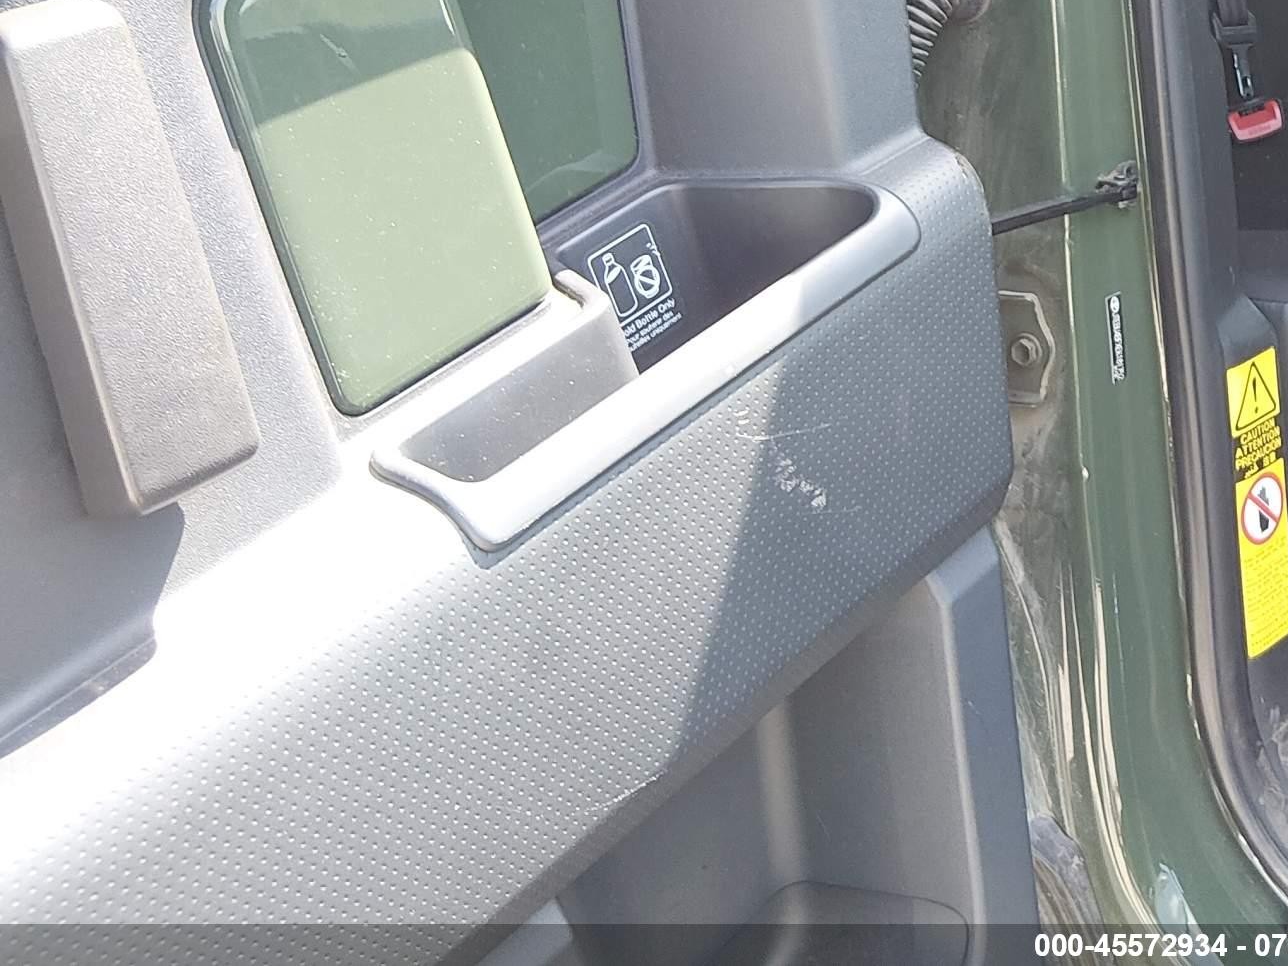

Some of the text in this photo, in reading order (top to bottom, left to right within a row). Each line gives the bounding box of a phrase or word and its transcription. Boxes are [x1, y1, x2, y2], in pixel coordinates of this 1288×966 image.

[624, 298, 675, 336] old Bottle Only
[1235, 426, 1280, 458] ATTENTION
[1240, 417, 1276, 445] CAUTION
